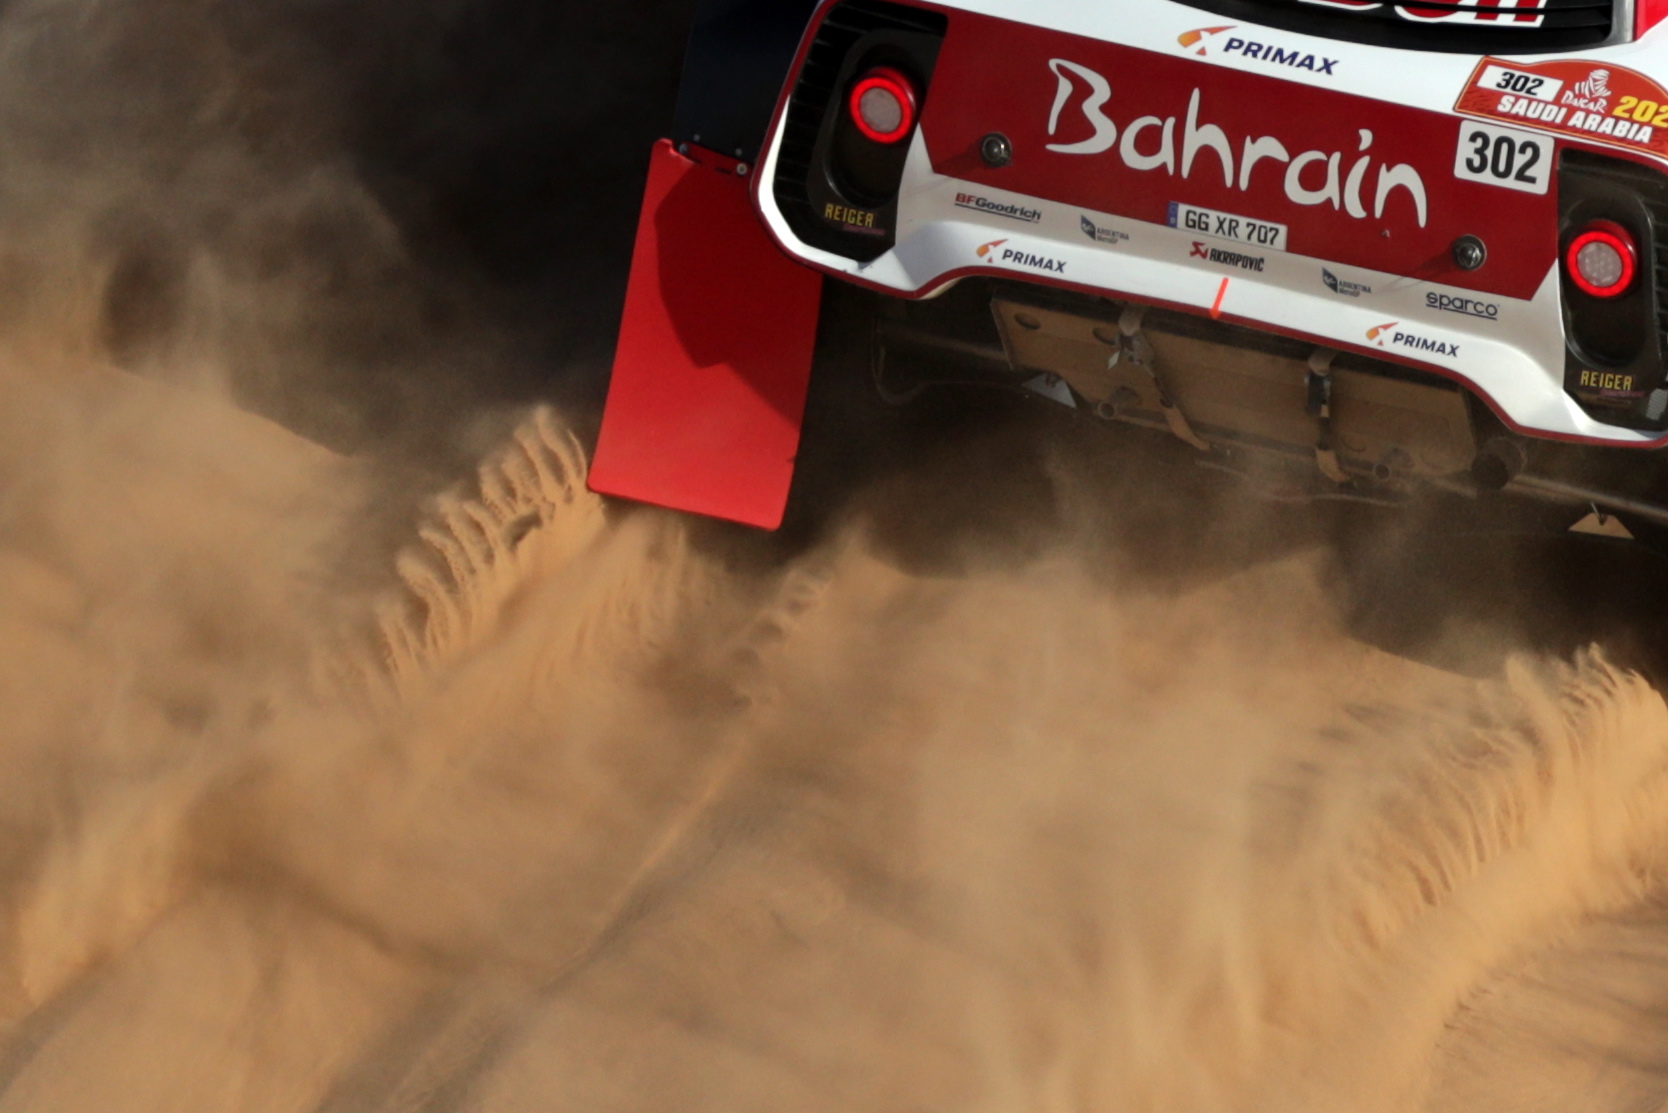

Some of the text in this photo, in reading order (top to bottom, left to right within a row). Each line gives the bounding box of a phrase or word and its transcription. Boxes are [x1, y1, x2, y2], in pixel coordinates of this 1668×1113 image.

[1223, 36, 1339, 76] PRIMAX
[1495, 70, 1546, 97] 302
[1561, 90, 1608, 114] DAKAR
[1497, 95, 1653, 144] SAUDI ARABIA
[1046, 58, 1428, 229] Bahrain
[1465, 129, 1541, 185] 302
[825, 203, 874, 228] REIGER
[955, 192, 1042, 222] BFGoodrich
[1185, 209, 1209, 232] GG
[1215, 215, 1239, 239] XR
[1246, 222, 1280, 246] 707
[1001, 248, 1067, 274] PRIMAX
[1426, 291, 1499, 319] sparco
[1393, 332, 1460, 358] PRIMAX
[1580, 370, 1633, 391] REIGER
